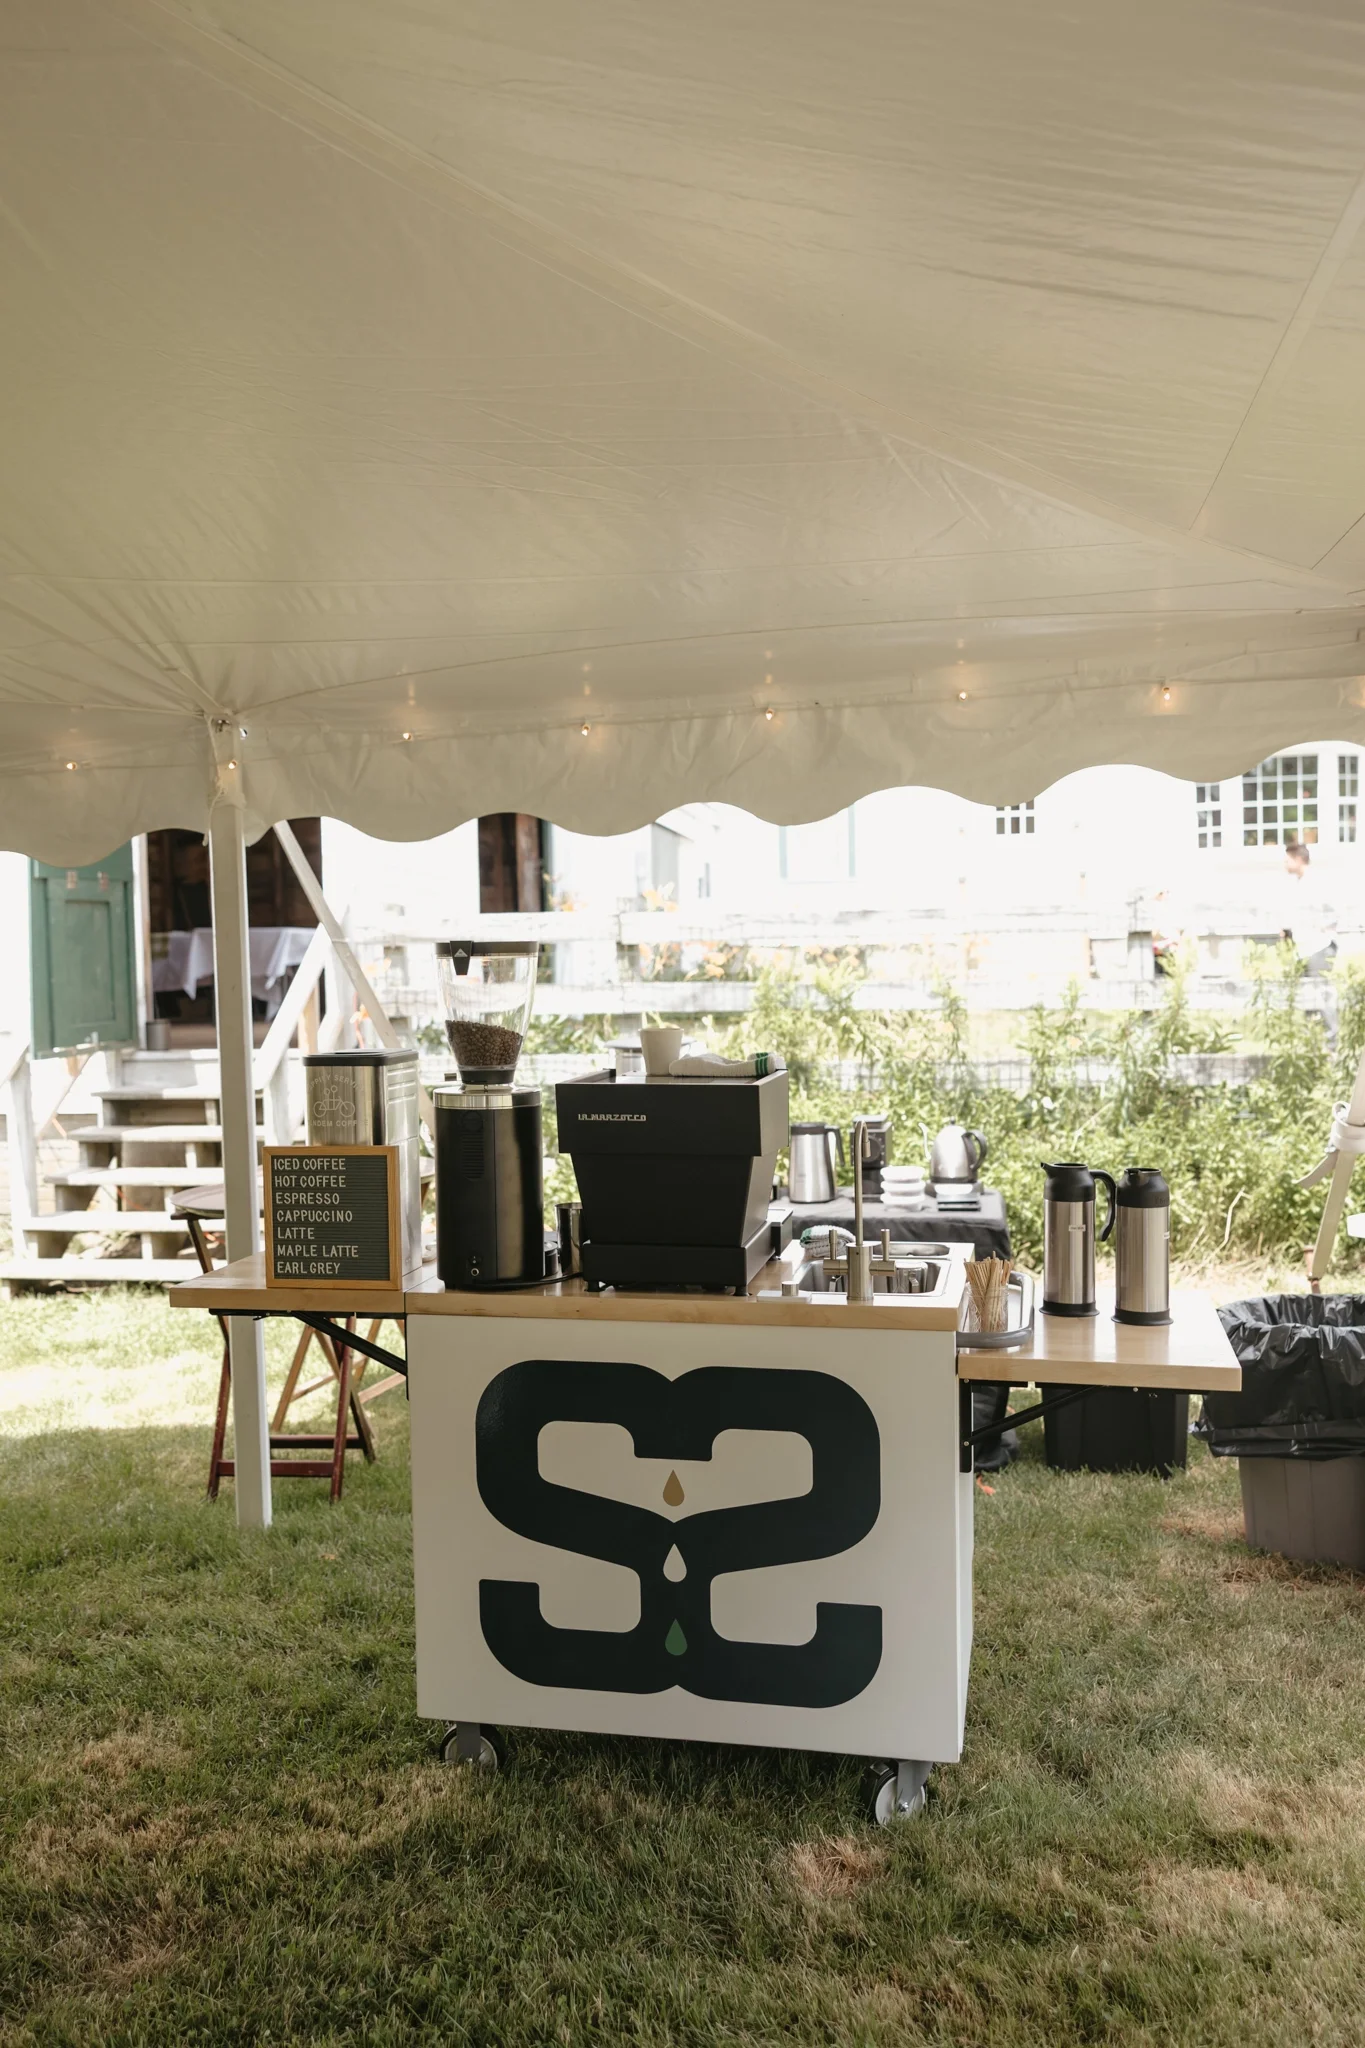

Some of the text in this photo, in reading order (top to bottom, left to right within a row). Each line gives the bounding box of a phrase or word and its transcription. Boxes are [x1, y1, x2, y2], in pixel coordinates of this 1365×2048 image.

[333, 1074, 364, 1092] SERVI
[309, 1119, 333, 1127] NDEM
[590, 1113, 647, 1122] MARZOCCO
[274, 1158, 346, 1170] ICED COFFEE
[274, 1175, 346, 1187] HOT COFFEE
[275, 1192, 340, 1205] ESPRESSO
[276, 1210, 353, 1222] CAPPUCCINO
[277, 1227, 315, 1239] LATTE
[277, 1244, 359, 1257] MAPLE LATTE
[277, 1261, 341, 1274] EARL GREY
